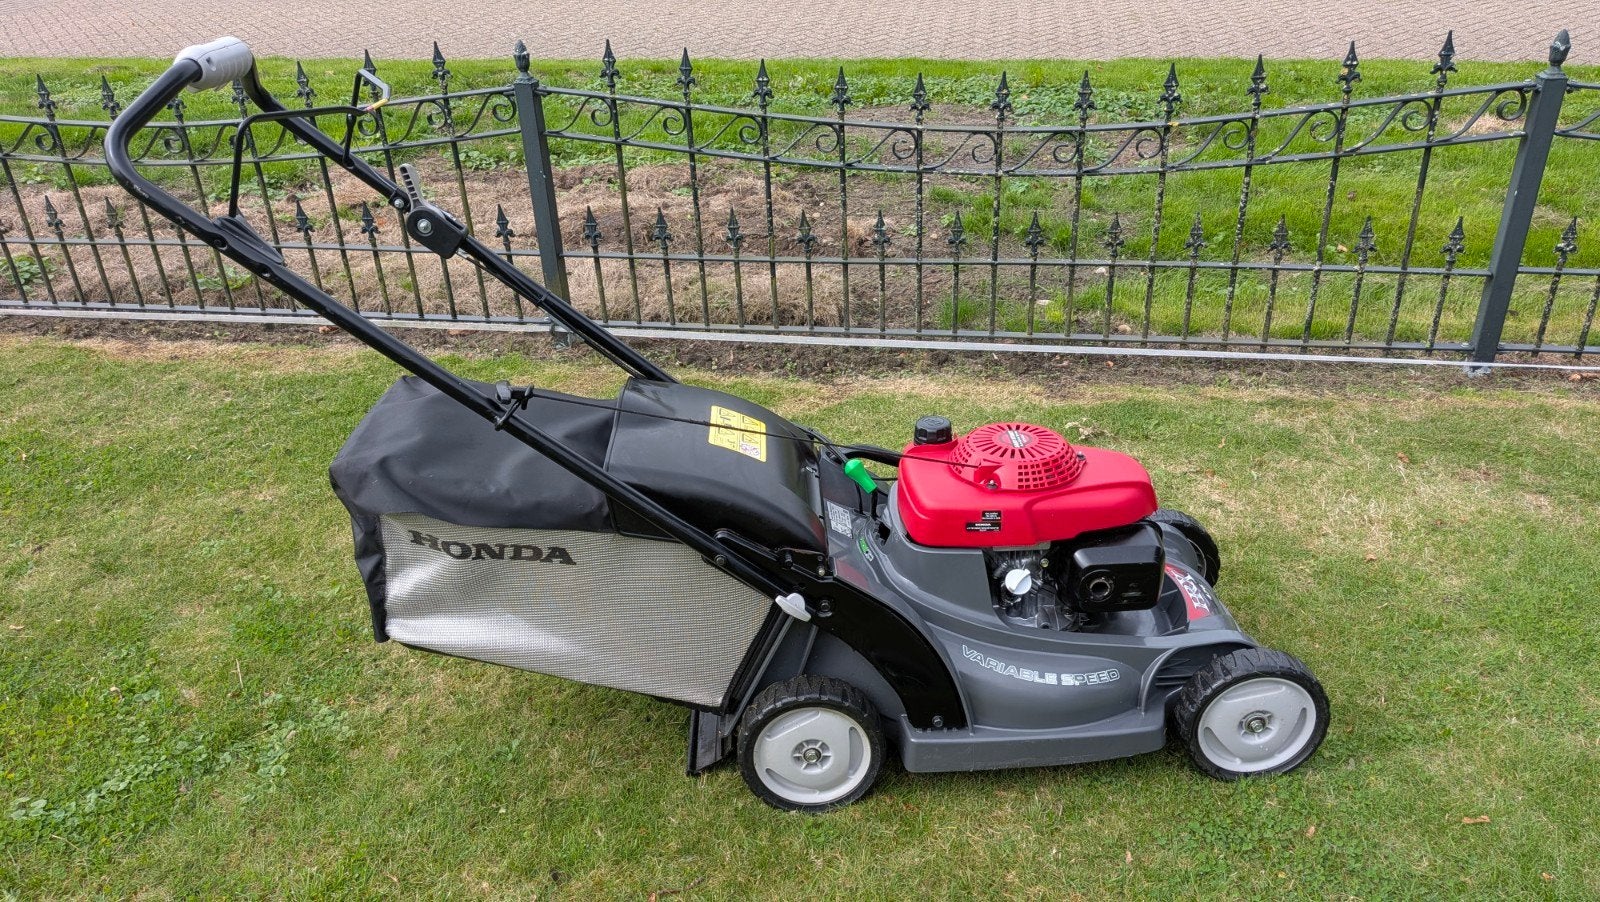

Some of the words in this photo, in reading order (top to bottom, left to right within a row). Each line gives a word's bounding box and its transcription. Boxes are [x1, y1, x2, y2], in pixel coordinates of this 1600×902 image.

[409, 530, 577, 565] HONDA
[962, 644, 1058, 685] VARIABLE
[1061, 669, 1121, 686] SPEED
